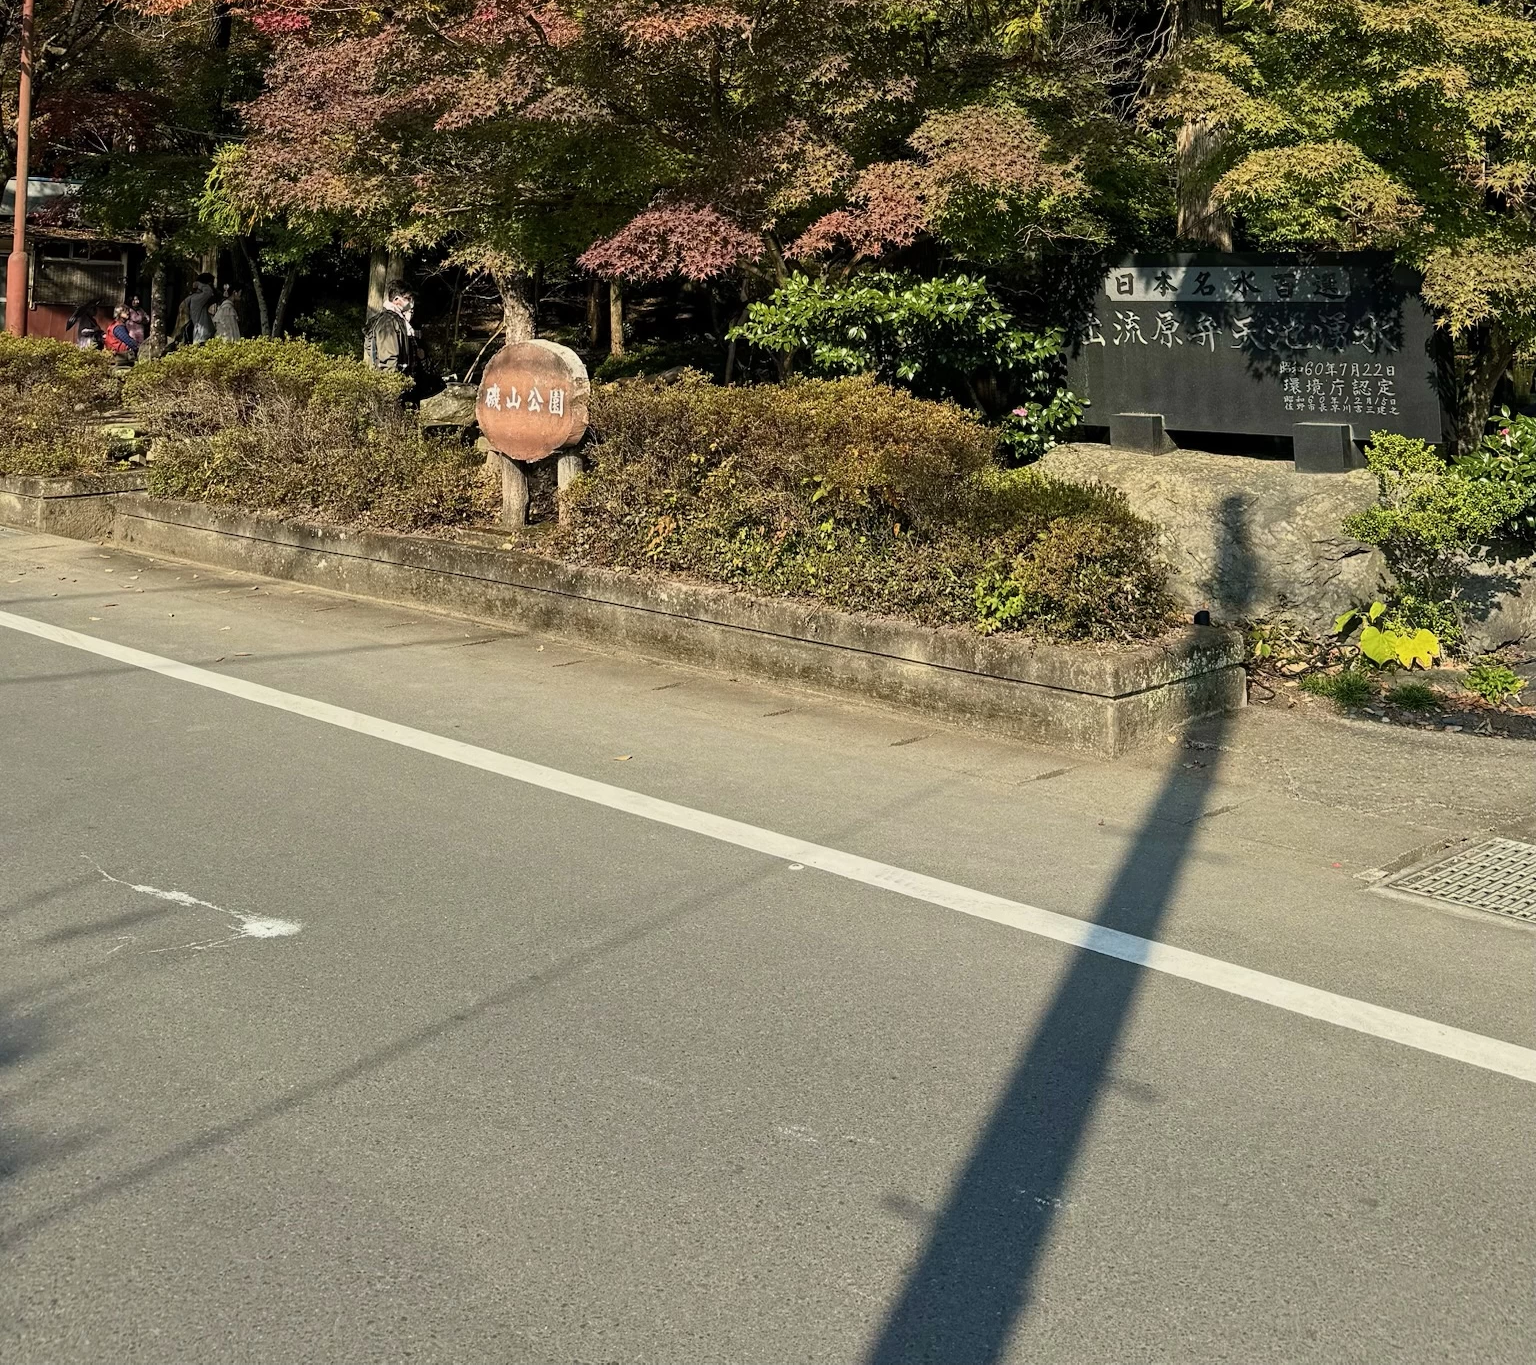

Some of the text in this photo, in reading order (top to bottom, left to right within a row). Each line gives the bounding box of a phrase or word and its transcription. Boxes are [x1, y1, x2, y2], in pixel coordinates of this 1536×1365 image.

[1115, 270, 1346, 300] 日本名水百選
[1279, 361, 1396, 377] 昭和60年7月22日
[1283, 378, 1396, 396] 環境庁認定
